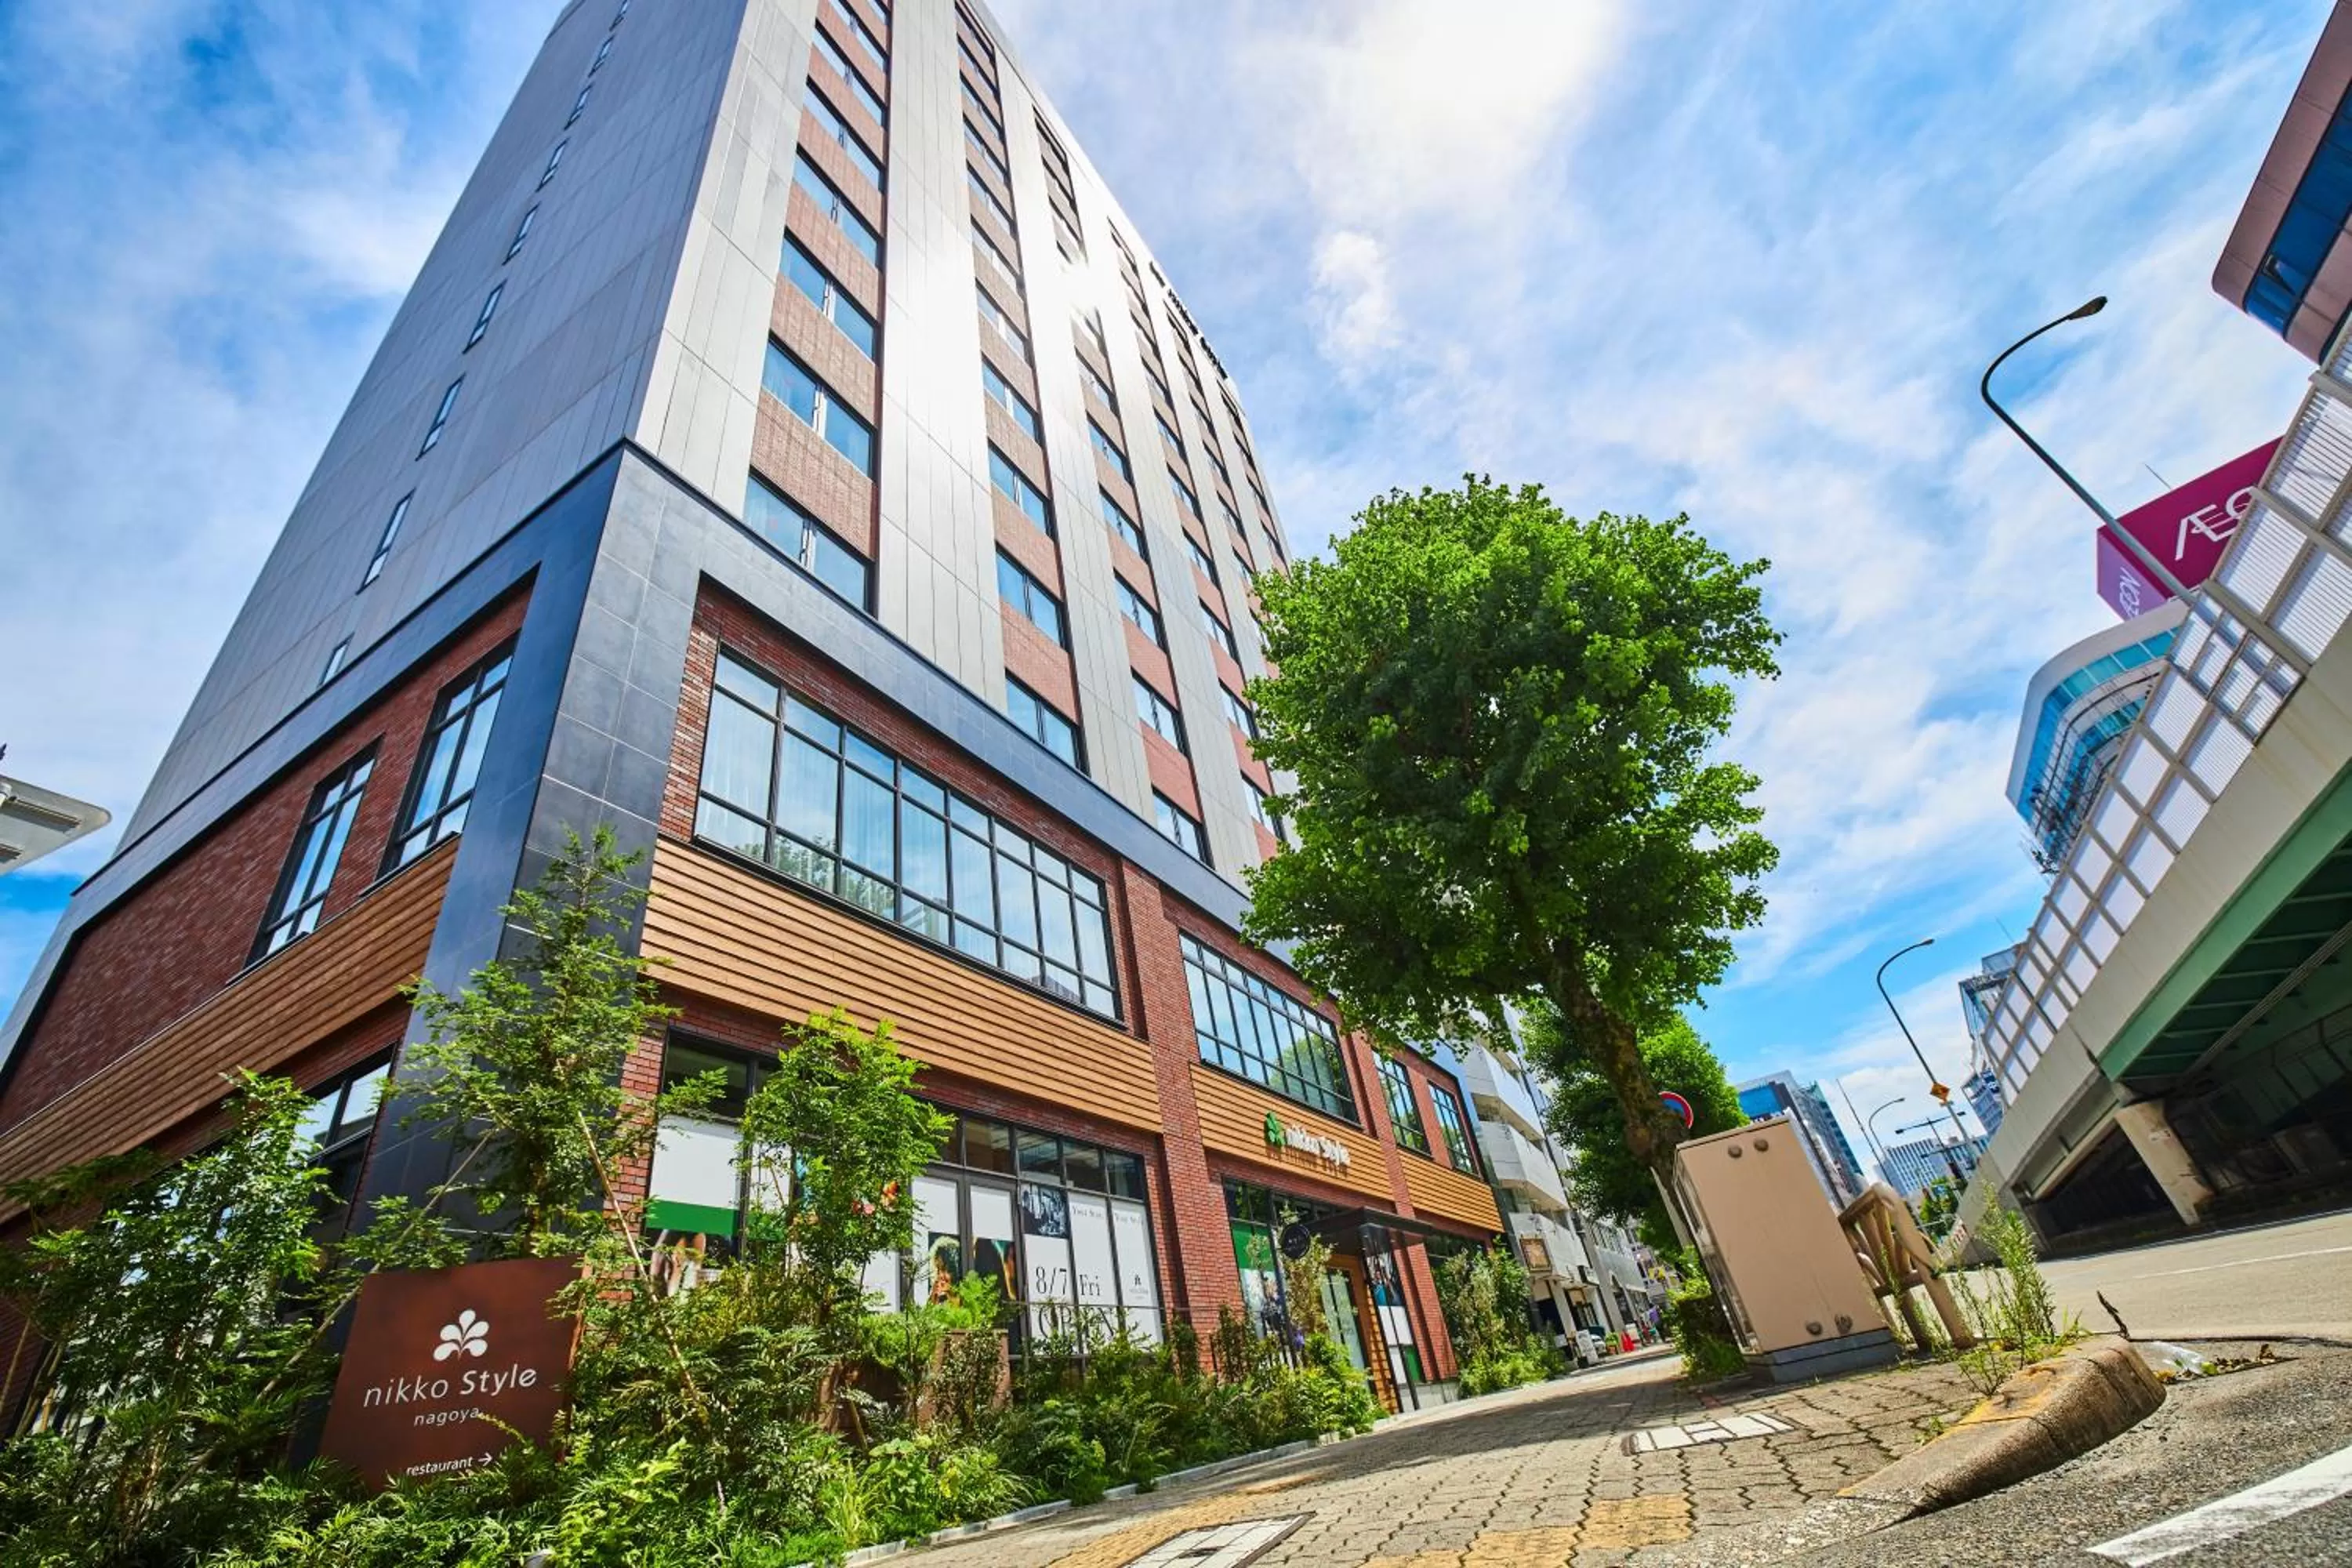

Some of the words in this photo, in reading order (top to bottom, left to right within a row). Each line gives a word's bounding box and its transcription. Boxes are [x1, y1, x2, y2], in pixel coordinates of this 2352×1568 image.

[1036, 1266, 1067, 1295] 8/7
[1079, 1274, 1101, 1296] Fri
[363, 1375, 449, 1407] nikko
[459, 1363, 537, 1396] Style
[413, 1407, 480, 1427] nagoya
[405, 1456, 473, 1476] restaurant
